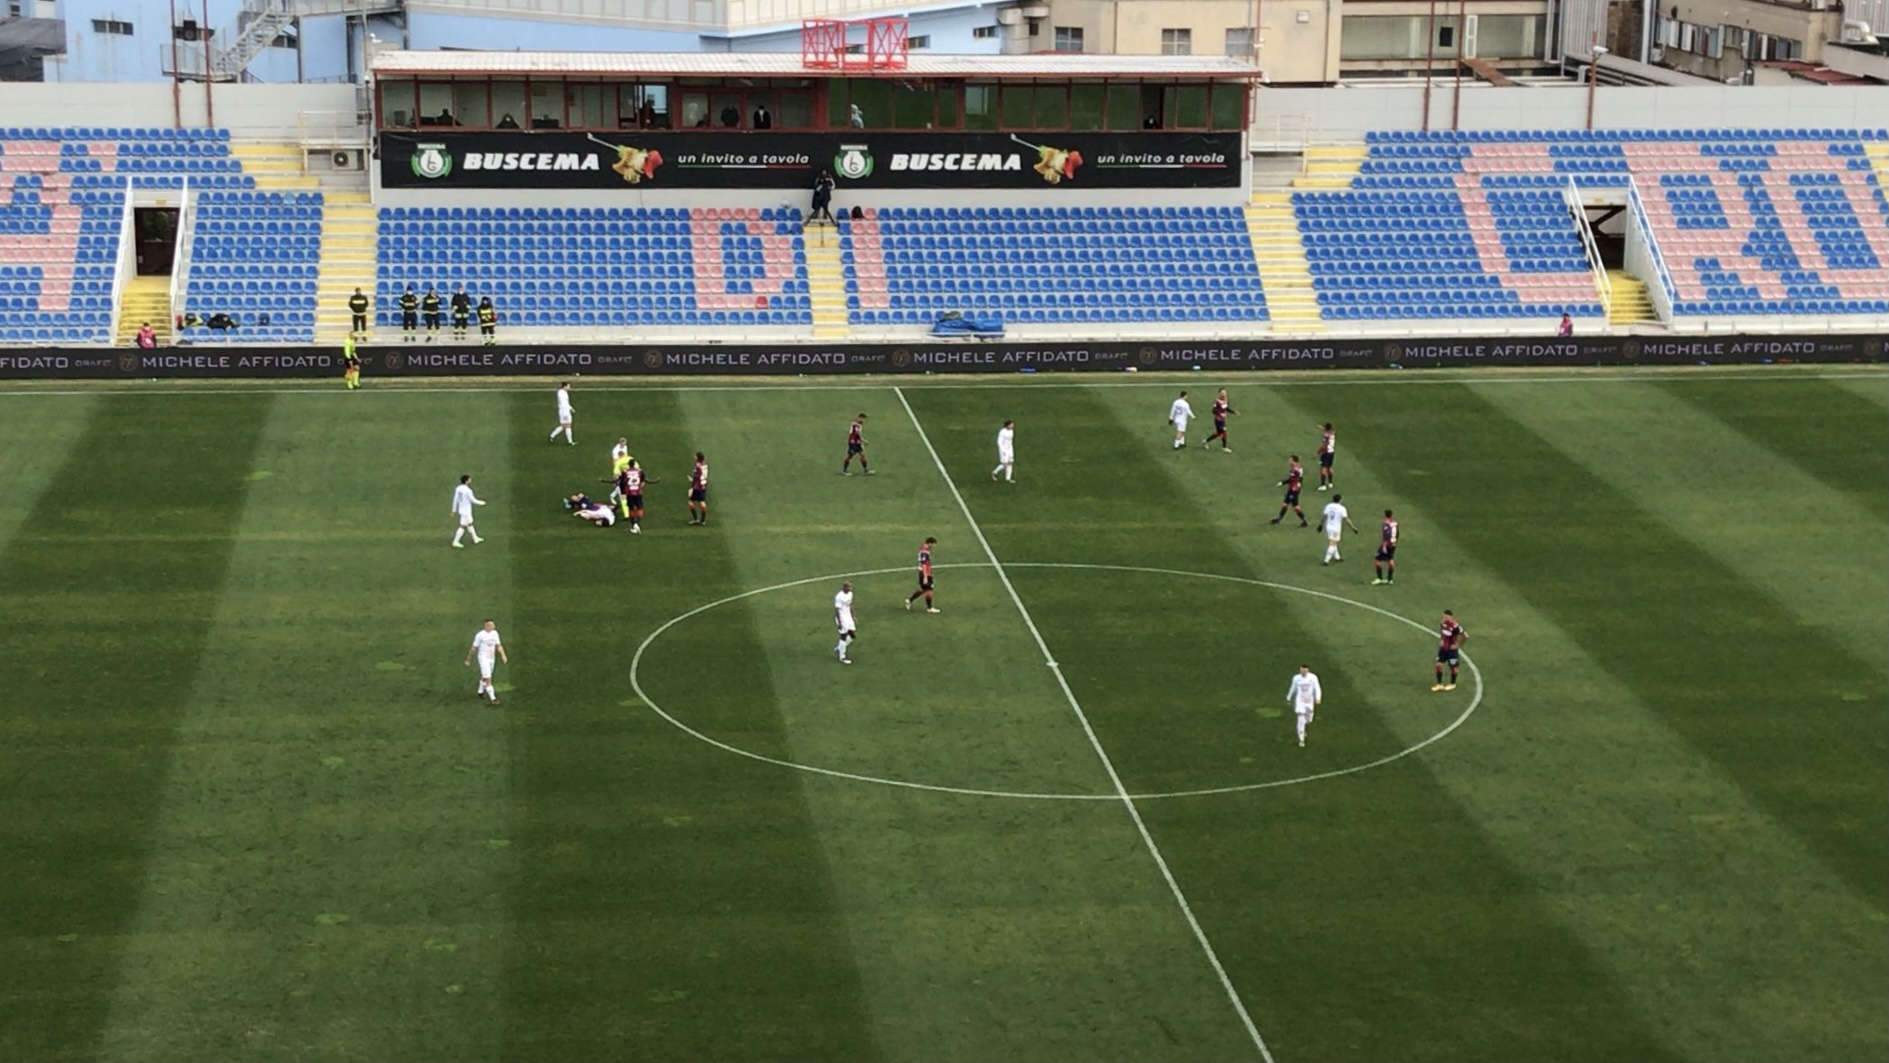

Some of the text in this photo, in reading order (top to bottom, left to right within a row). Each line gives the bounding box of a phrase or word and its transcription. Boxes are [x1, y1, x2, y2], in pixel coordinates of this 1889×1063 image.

[462, 152, 600, 171] BUSCEMA
[678, 153, 809, 164] un invito a tavola
[889, 153, 1022, 171] BUSCEMA
[1097, 153, 1226, 164] un invito a tavola
[1160, 350, 1241, 362] MICHELE
[1247, 348, 1334, 361] AFFIDATO
[1405, 346, 1486, 359] MICHELE
[1492, 344, 1578, 357] AFFIDATO
[1643, 343, 1724, 356] MICHELE
[1730, 342, 1815, 354] AFFIDATO
[142, 356, 230, 369] MICHELE
[238, 355, 331, 368] AFFIDATO
[408, 354, 494, 366] MICHELE
[500, 353, 592, 366] AFFIDATO
[666, 353, 750, 365] MICHELE
[757, 353, 846, 365] AFFIDATO
[913, 352, 996, 364] MICHELE
[1002, 351, 1089, 363] AFFIDATO
